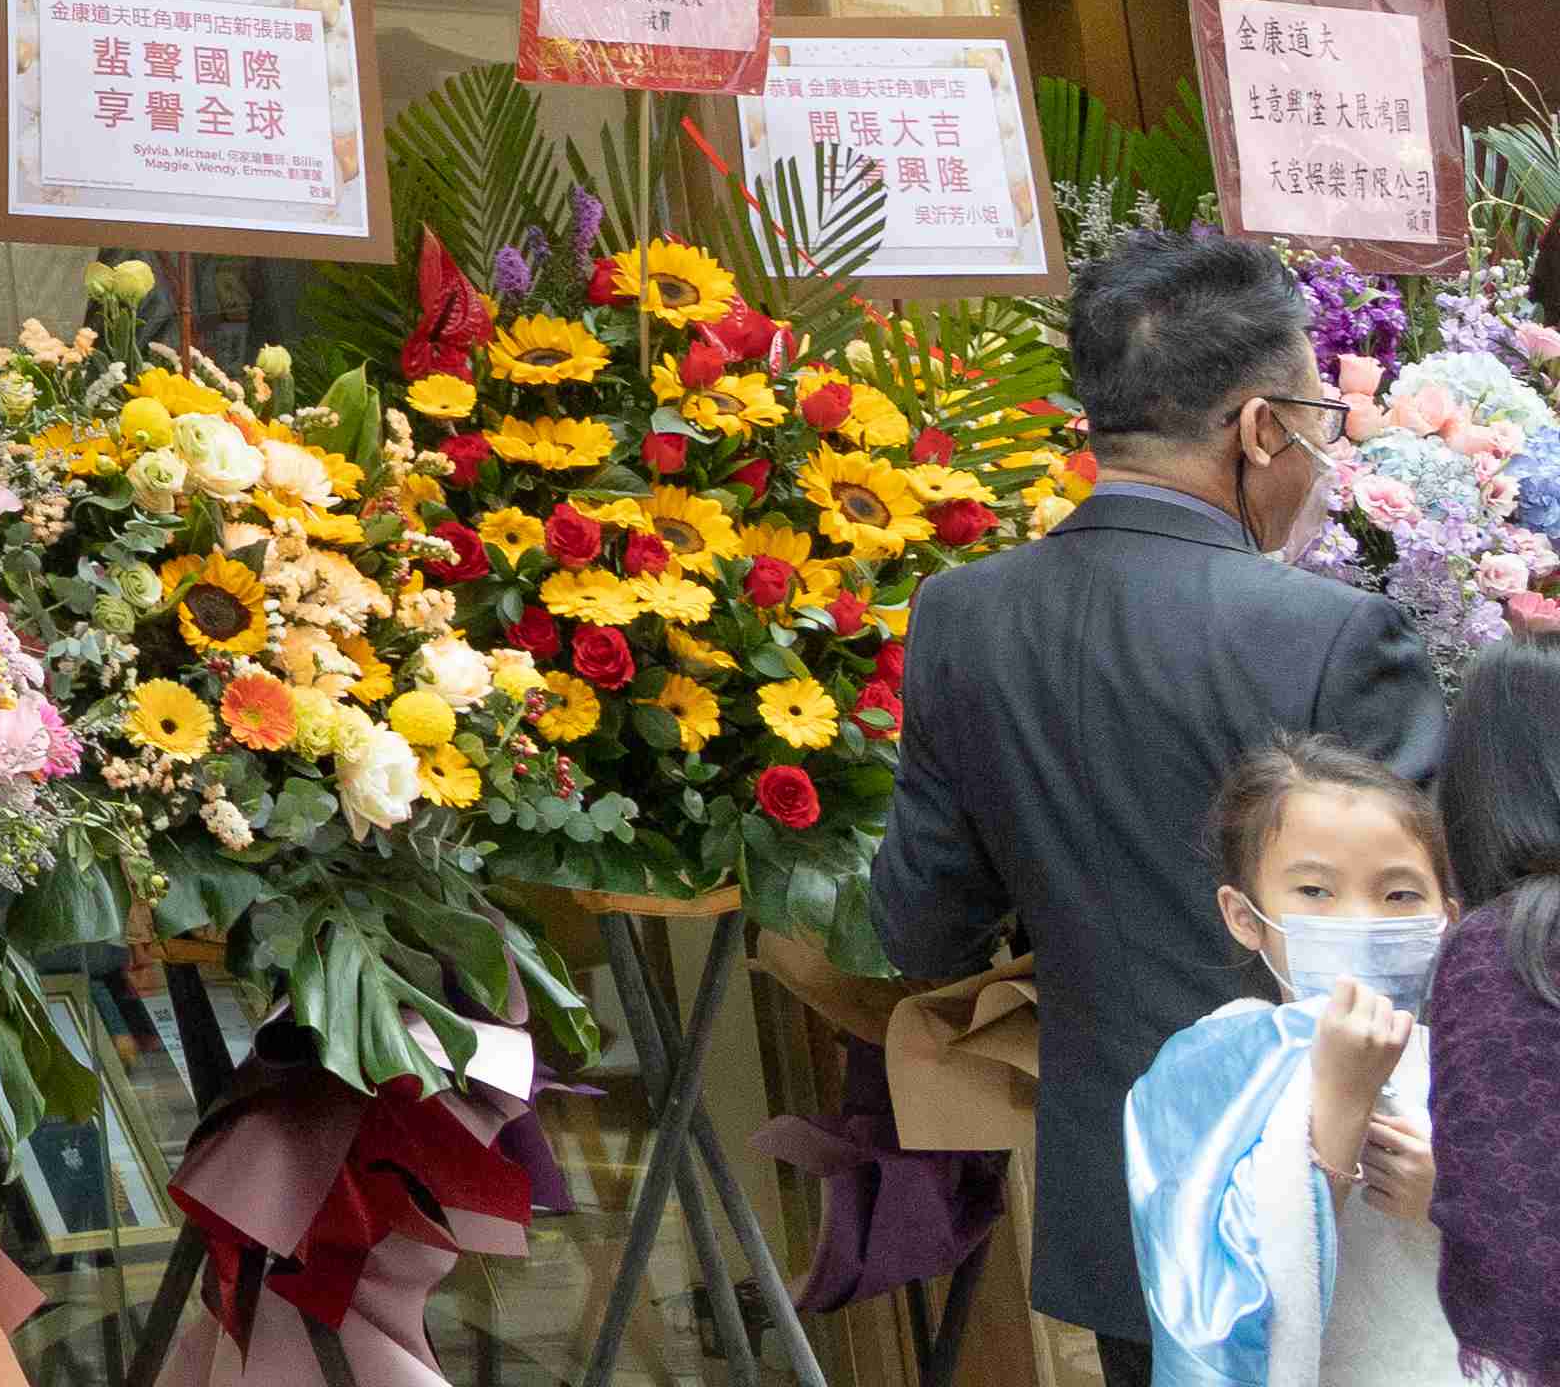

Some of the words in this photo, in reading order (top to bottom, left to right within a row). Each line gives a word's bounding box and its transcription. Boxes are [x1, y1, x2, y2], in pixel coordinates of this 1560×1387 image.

[1235, 14, 1342, 62] 金康道夫
[92, 36, 282, 92] 蜚聲國際
[93, 87, 286, 140] 享譽全球
[807, 110, 962, 148] 開張大吉
[1248, 83, 1326, 127] 生意興隆
[1336, 92, 1412, 134] 大展鴻圖
